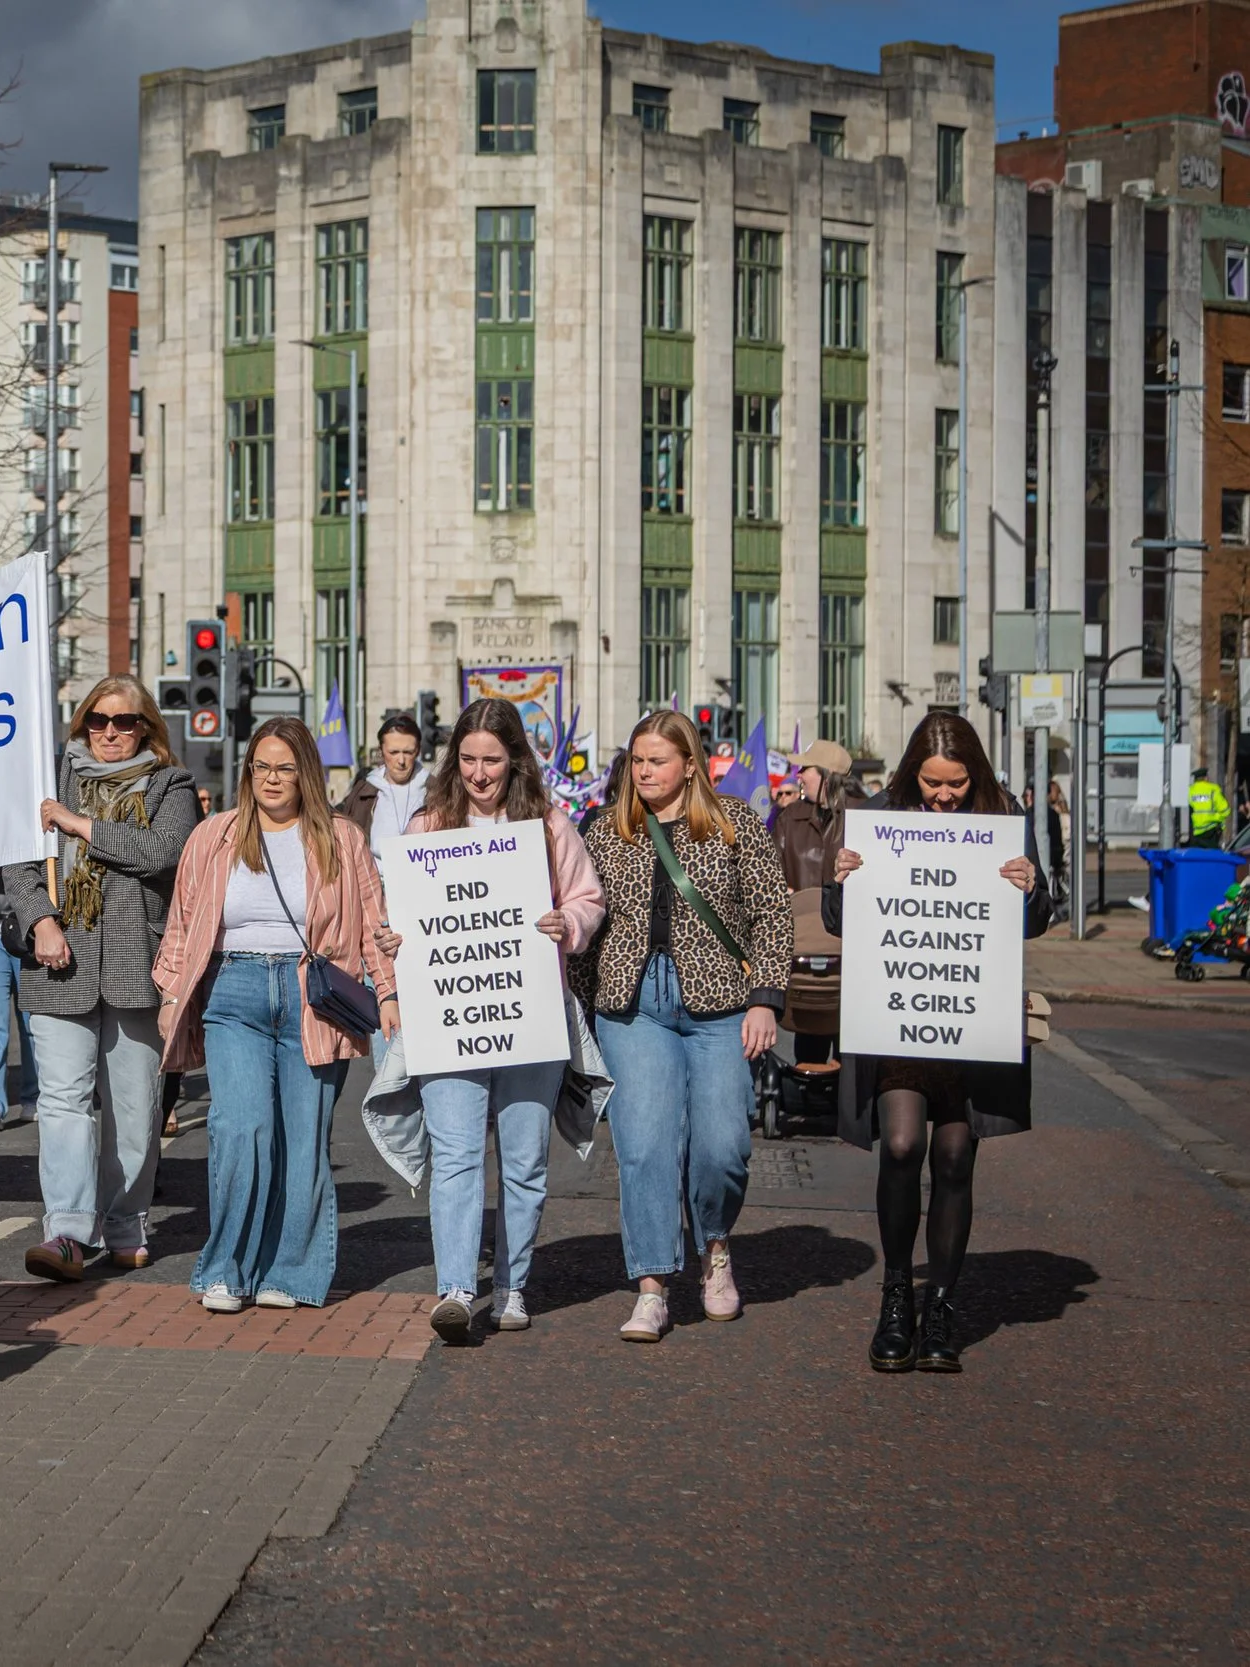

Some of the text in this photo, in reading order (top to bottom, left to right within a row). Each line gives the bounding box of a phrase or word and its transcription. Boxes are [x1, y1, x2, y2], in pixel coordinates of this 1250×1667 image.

[473, 617, 534, 631] BANK OF
[473, 634, 534, 648] IRELAND
[874, 826, 993, 858] Women's Aid
[407, 837, 517, 878] Women's Aid
[910, 868, 957, 887] END
[446, 881, 489, 902] END
[876, 897, 990, 921] VIOLENCE
[419, 908, 524, 936] VIOLENCE
[880, 929, 985, 952] AGAINST
[428, 939, 522, 967] AGAINST
[434, 970, 523, 996] WOMEN
[884, 961, 980, 983] WOMEN
[442, 1001, 523, 1027] & GIRLS
[887, 992, 976, 1015] & GIRLS
[457, 1034, 514, 1056] NOW
[900, 1024, 963, 1045] NOW
